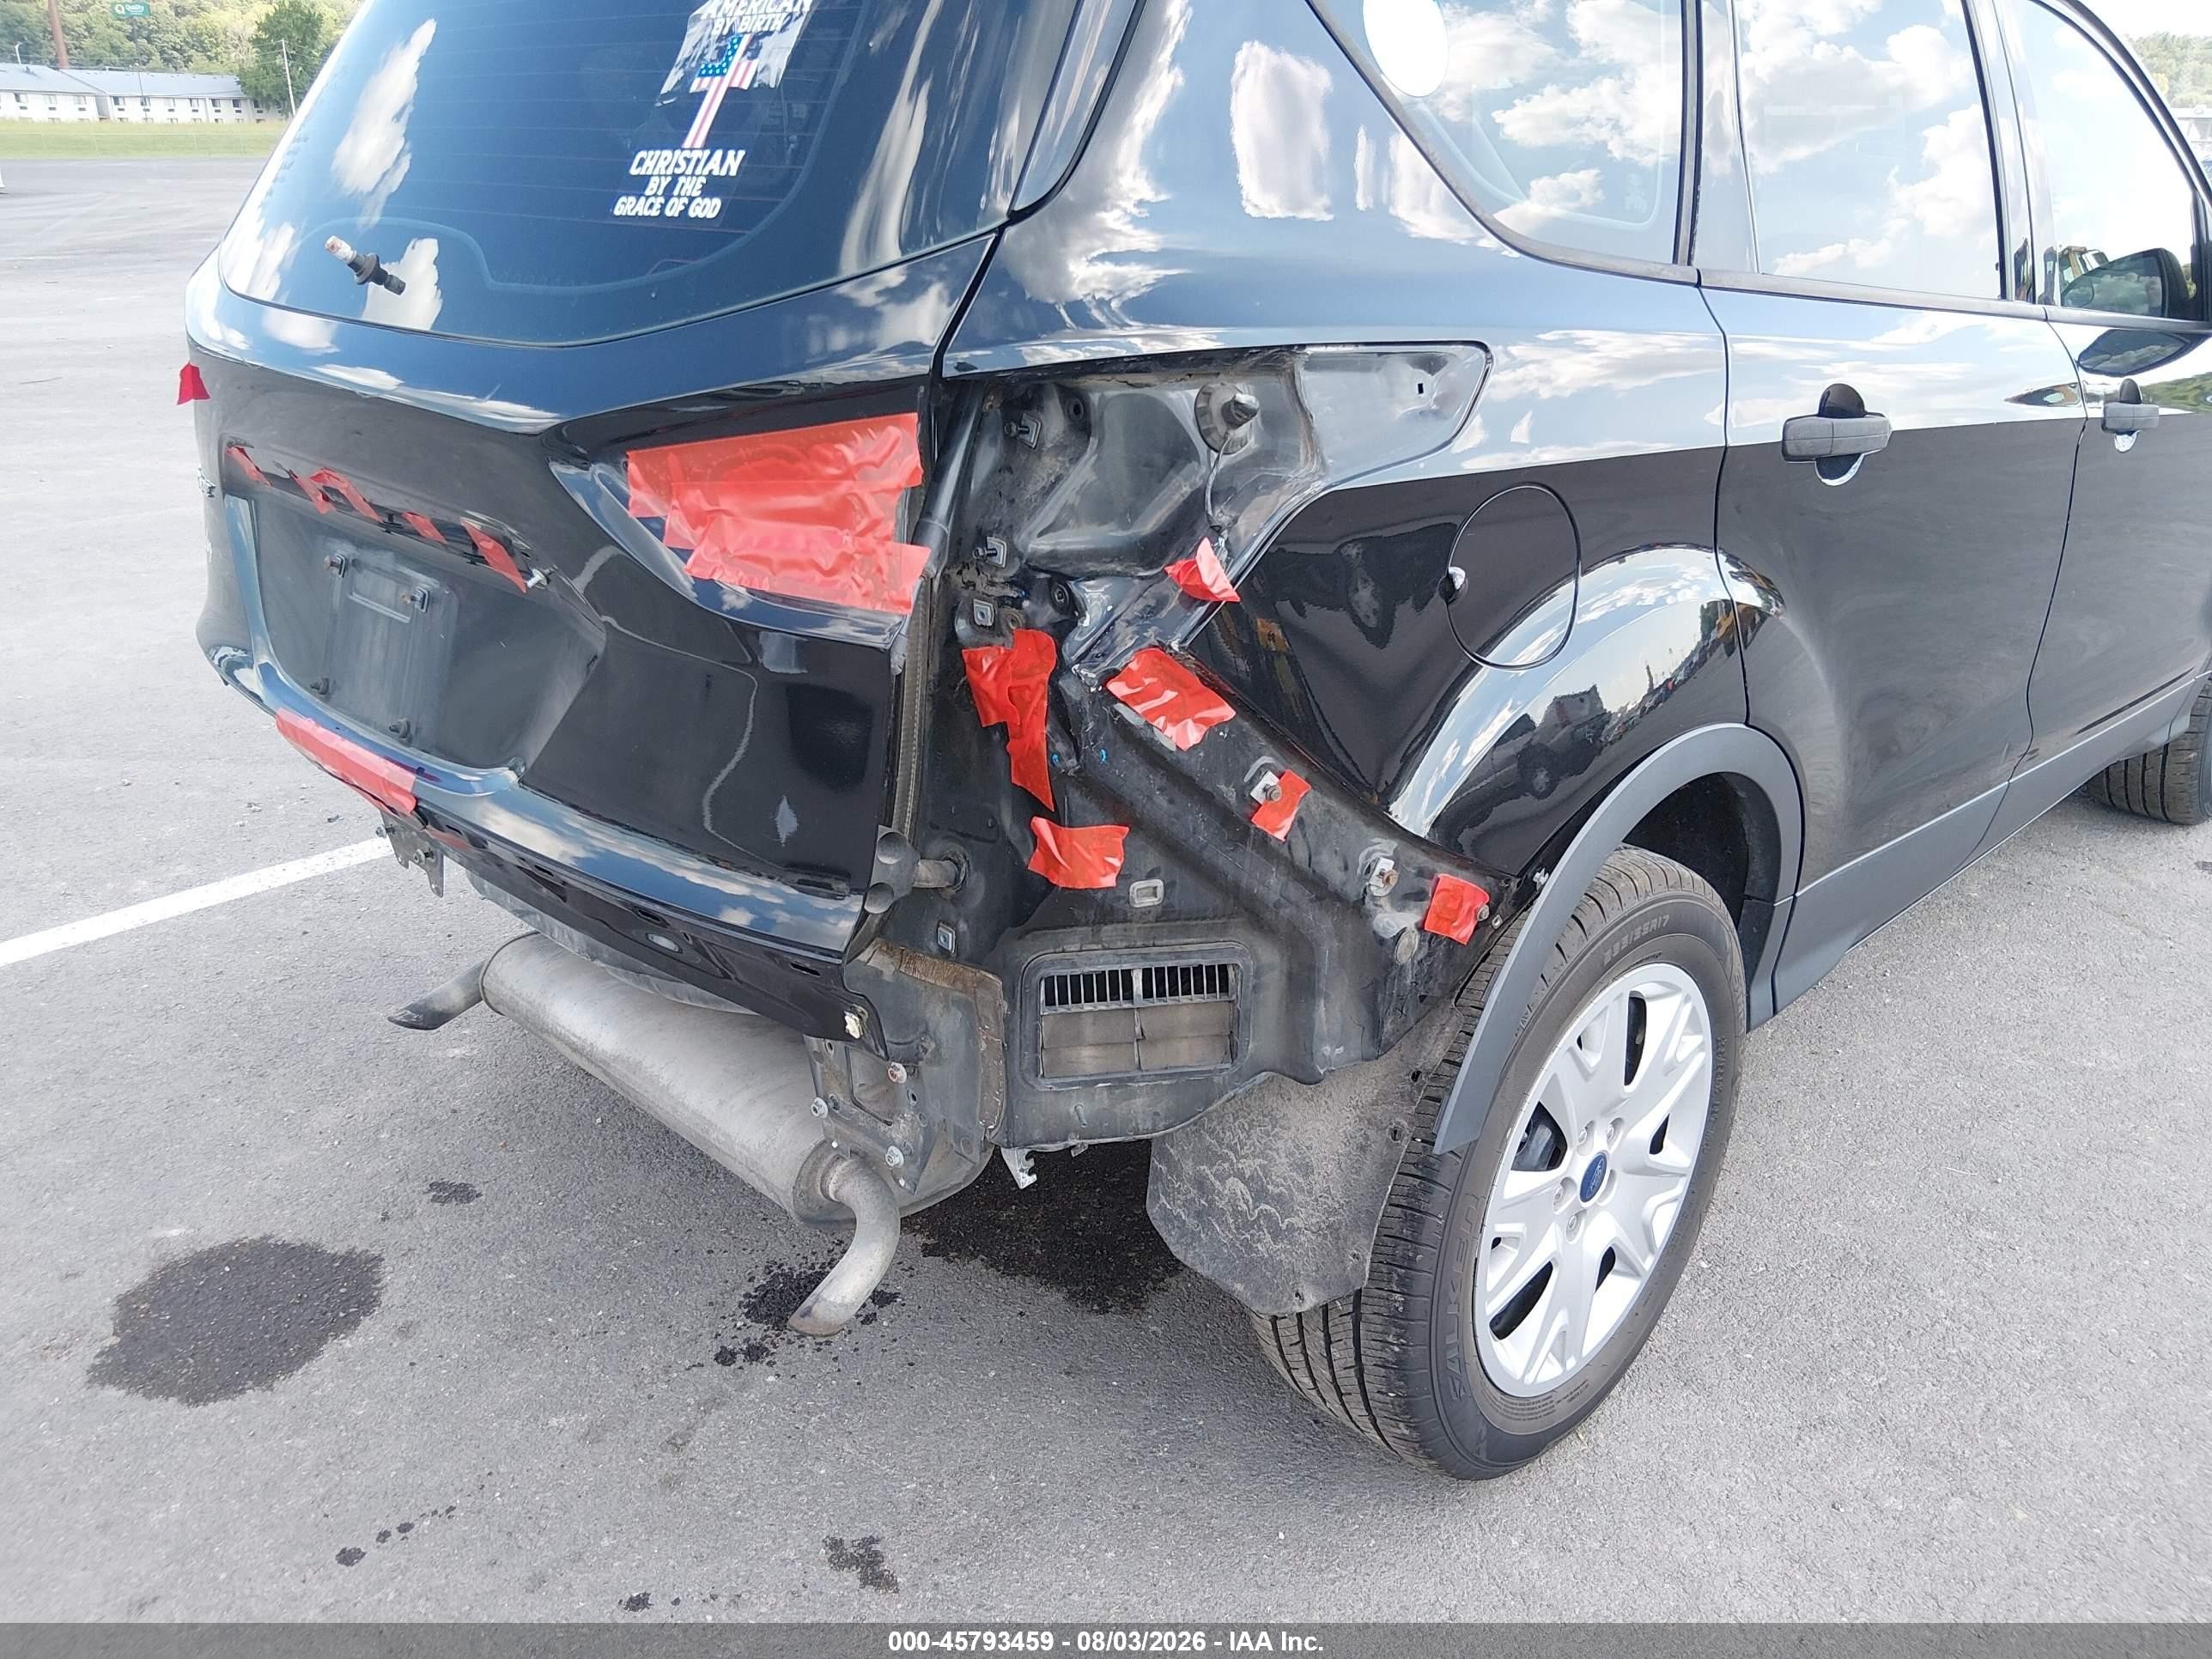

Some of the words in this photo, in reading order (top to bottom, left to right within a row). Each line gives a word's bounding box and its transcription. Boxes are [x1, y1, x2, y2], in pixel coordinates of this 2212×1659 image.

[700, 0, 814, 19] AMERICAN
[711, 17, 737, 35] BY
[737, 11, 788, 33] BIRTH
[629, 149, 746, 176] CHRISTIAN
[644, 176, 672, 197] BY
[672, 176, 707, 198] THE
[613, 196, 665, 217] GRACE
[665, 197, 689, 217] OF
[688, 198, 722, 219] GOD
